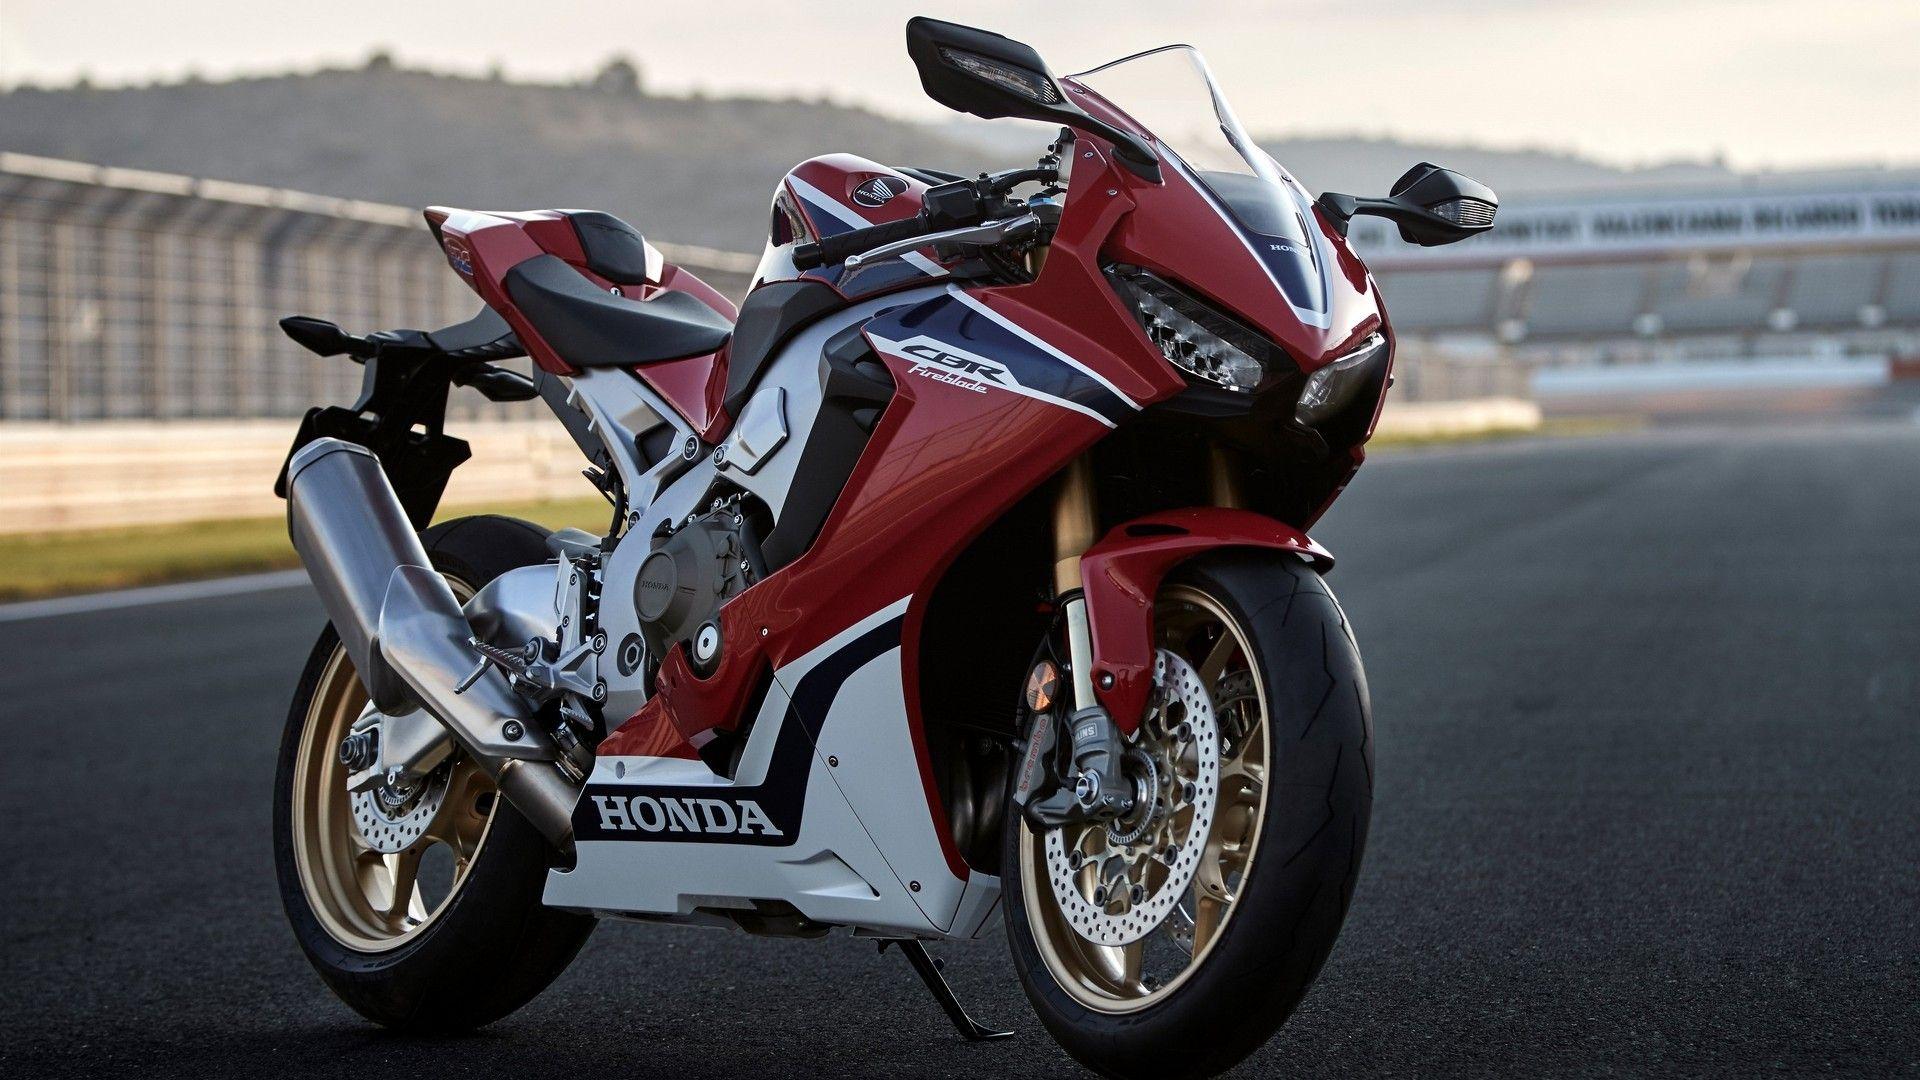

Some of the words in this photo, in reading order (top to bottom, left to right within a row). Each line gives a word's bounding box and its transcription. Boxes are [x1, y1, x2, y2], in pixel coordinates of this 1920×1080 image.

[901, 345, 1007, 385] CBR
[907, 364, 987, 394] Fireblade
[592, 795, 783, 835] HONDA
